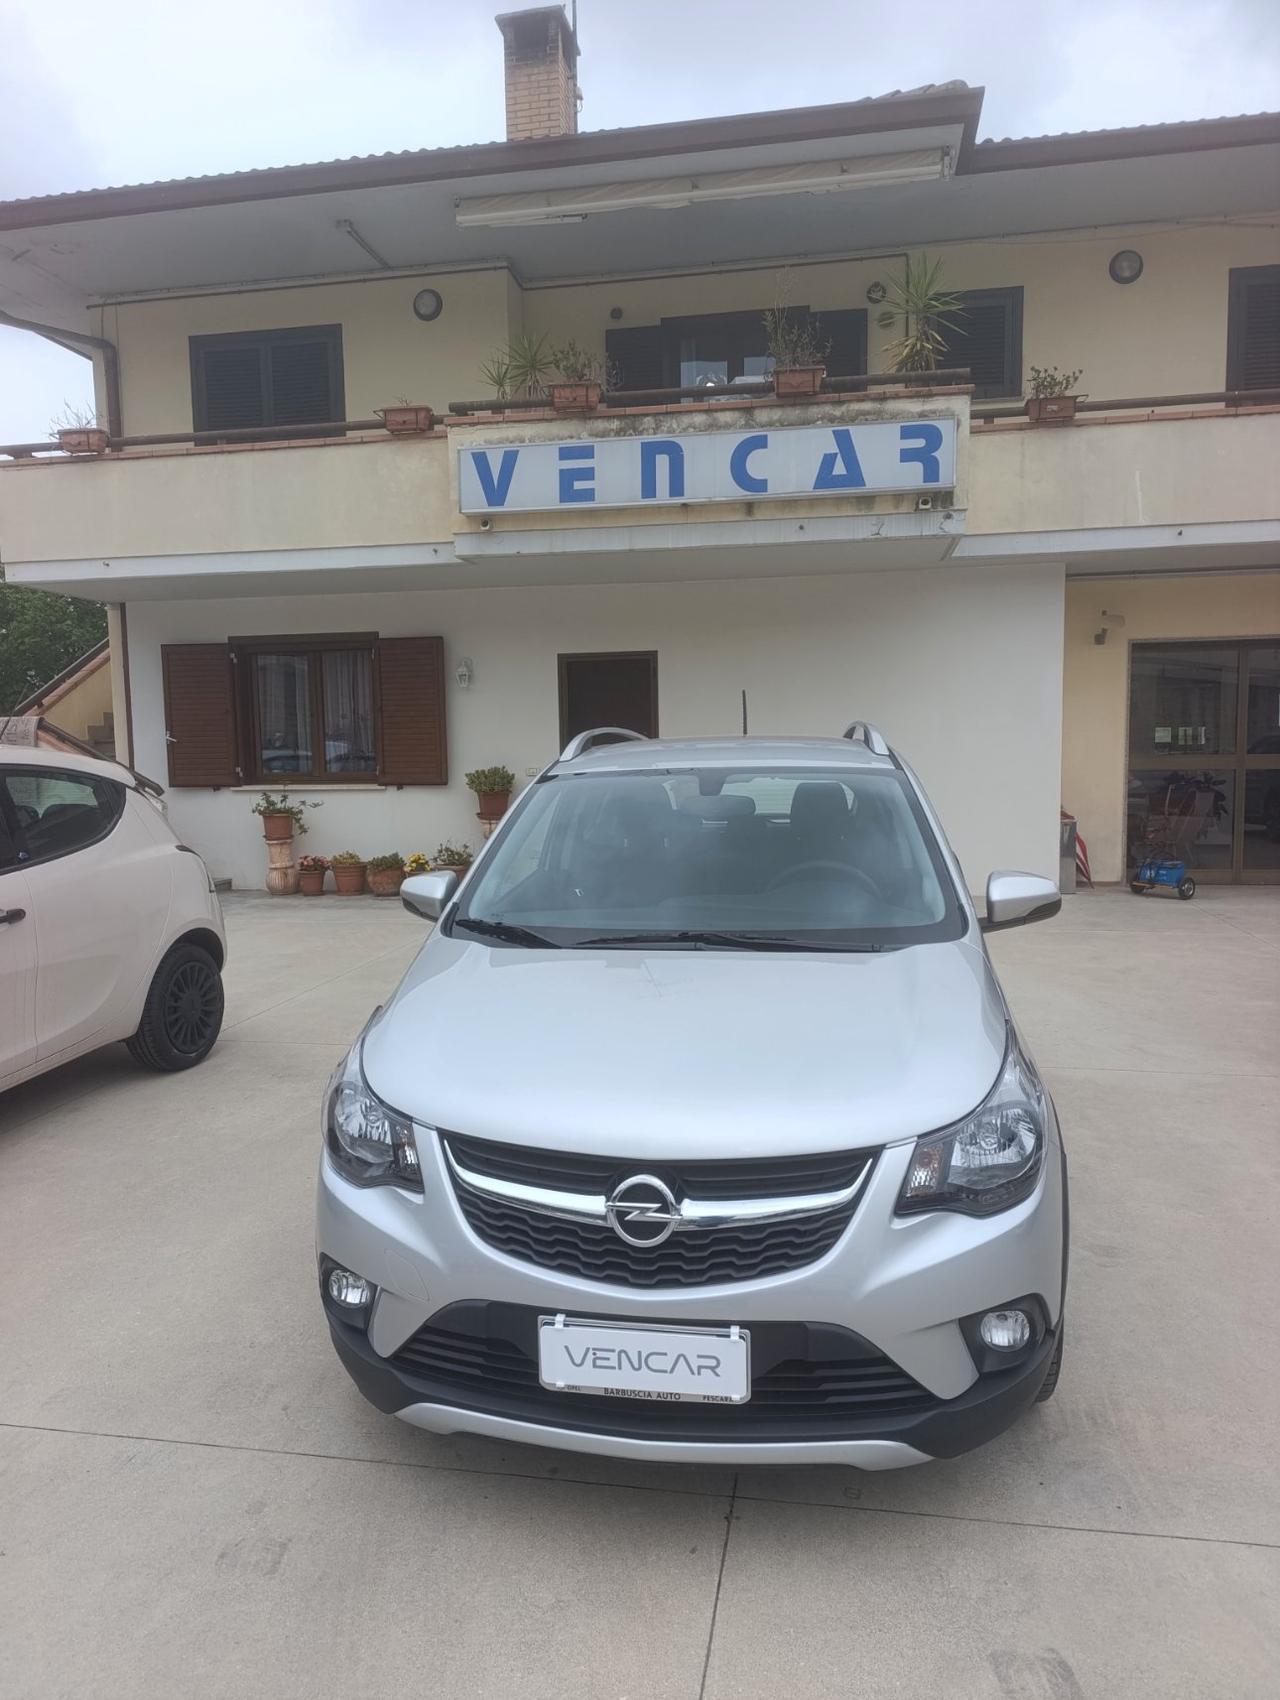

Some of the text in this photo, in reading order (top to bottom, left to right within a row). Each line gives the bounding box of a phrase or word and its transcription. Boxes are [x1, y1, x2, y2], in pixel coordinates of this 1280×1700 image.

[471, 423, 943, 507] VENCAR
[564, 1345, 721, 1377] VENCAR
[603, 1387, 652, 1399] BARBUSCIA
[656, 1392, 681, 1401] AUTO
